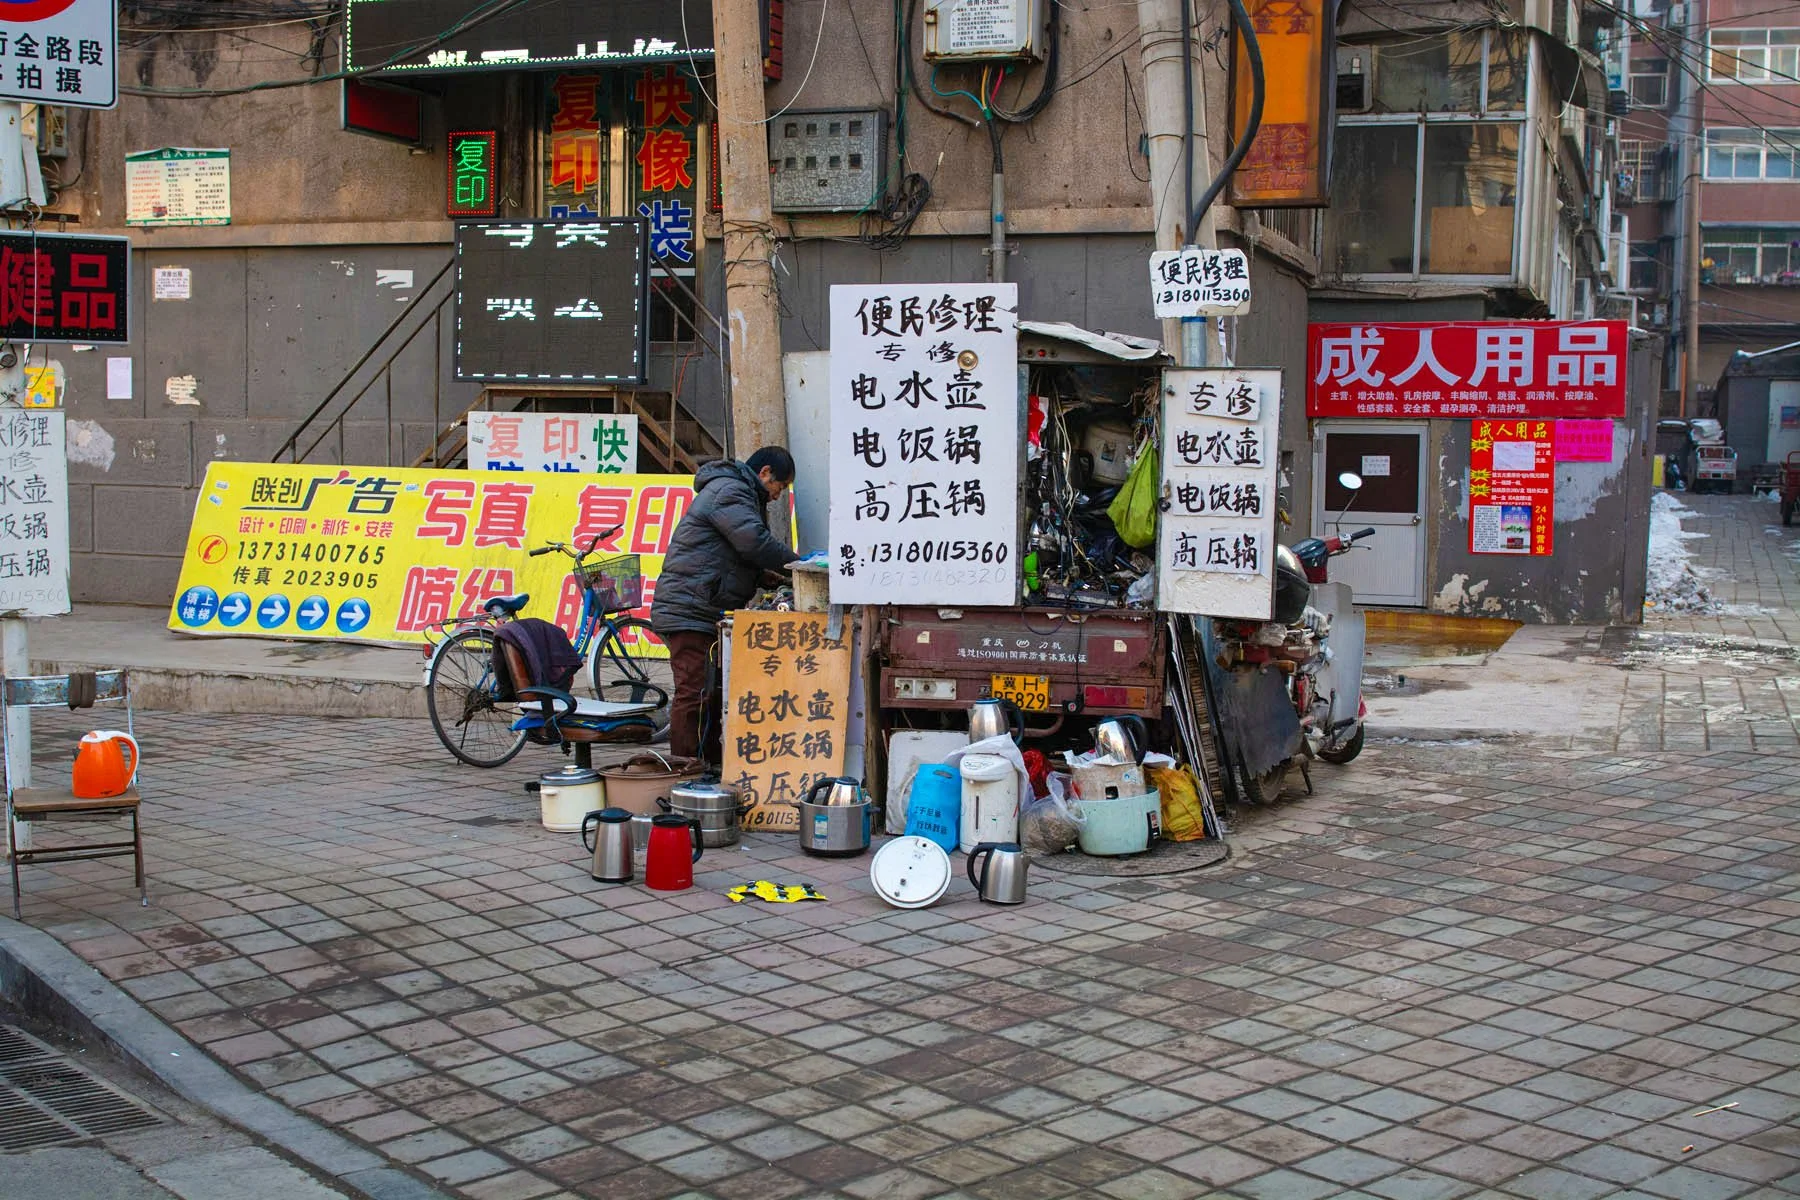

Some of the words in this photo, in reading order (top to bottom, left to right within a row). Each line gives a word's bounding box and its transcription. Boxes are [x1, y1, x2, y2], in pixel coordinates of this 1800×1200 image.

[0, 62, 82, 94] 拍摄
[455, 140, 487, 207] 复印
[1158, 256, 1247, 287] 便民修理
[1156, 288, 1250, 305] 13180115360
[855, 294, 1003, 338] 便民修理
[876, 342, 959, 364] 专修
[1315, 326, 1618, 387] 成人用品
[851, 370, 986, 411] 电水壶
[1190, 381, 1256, 416] 专修
[0, 411, 52, 449] 修理
[853, 424, 982, 468] 电饭锅
[1177, 427, 1261, 465] 电水壶
[1480, 421, 1548, 441] 成人用品
[0, 451, 43, 473] 修
[240, 470, 402, 514] 联创广告
[855, 480, 986, 523] 高压锅
[1177, 482, 1261, 516] 电饭锅
[416, 480, 535, 549] 写真
[572, 485, 696, 555] 复印
[238, 541, 385, 565] 13731400765
[871, 540, 1008, 564] 13180115360
[1172, 531, 1258, 570] 高压锅
[233, 565, 272, 586] 传真
[283, 569, 377, 588] 2023905
[760, 654, 820, 677] 专修
[738, 689, 834, 724] 电水壶
[736, 730, 833, 764] 电饭锅
